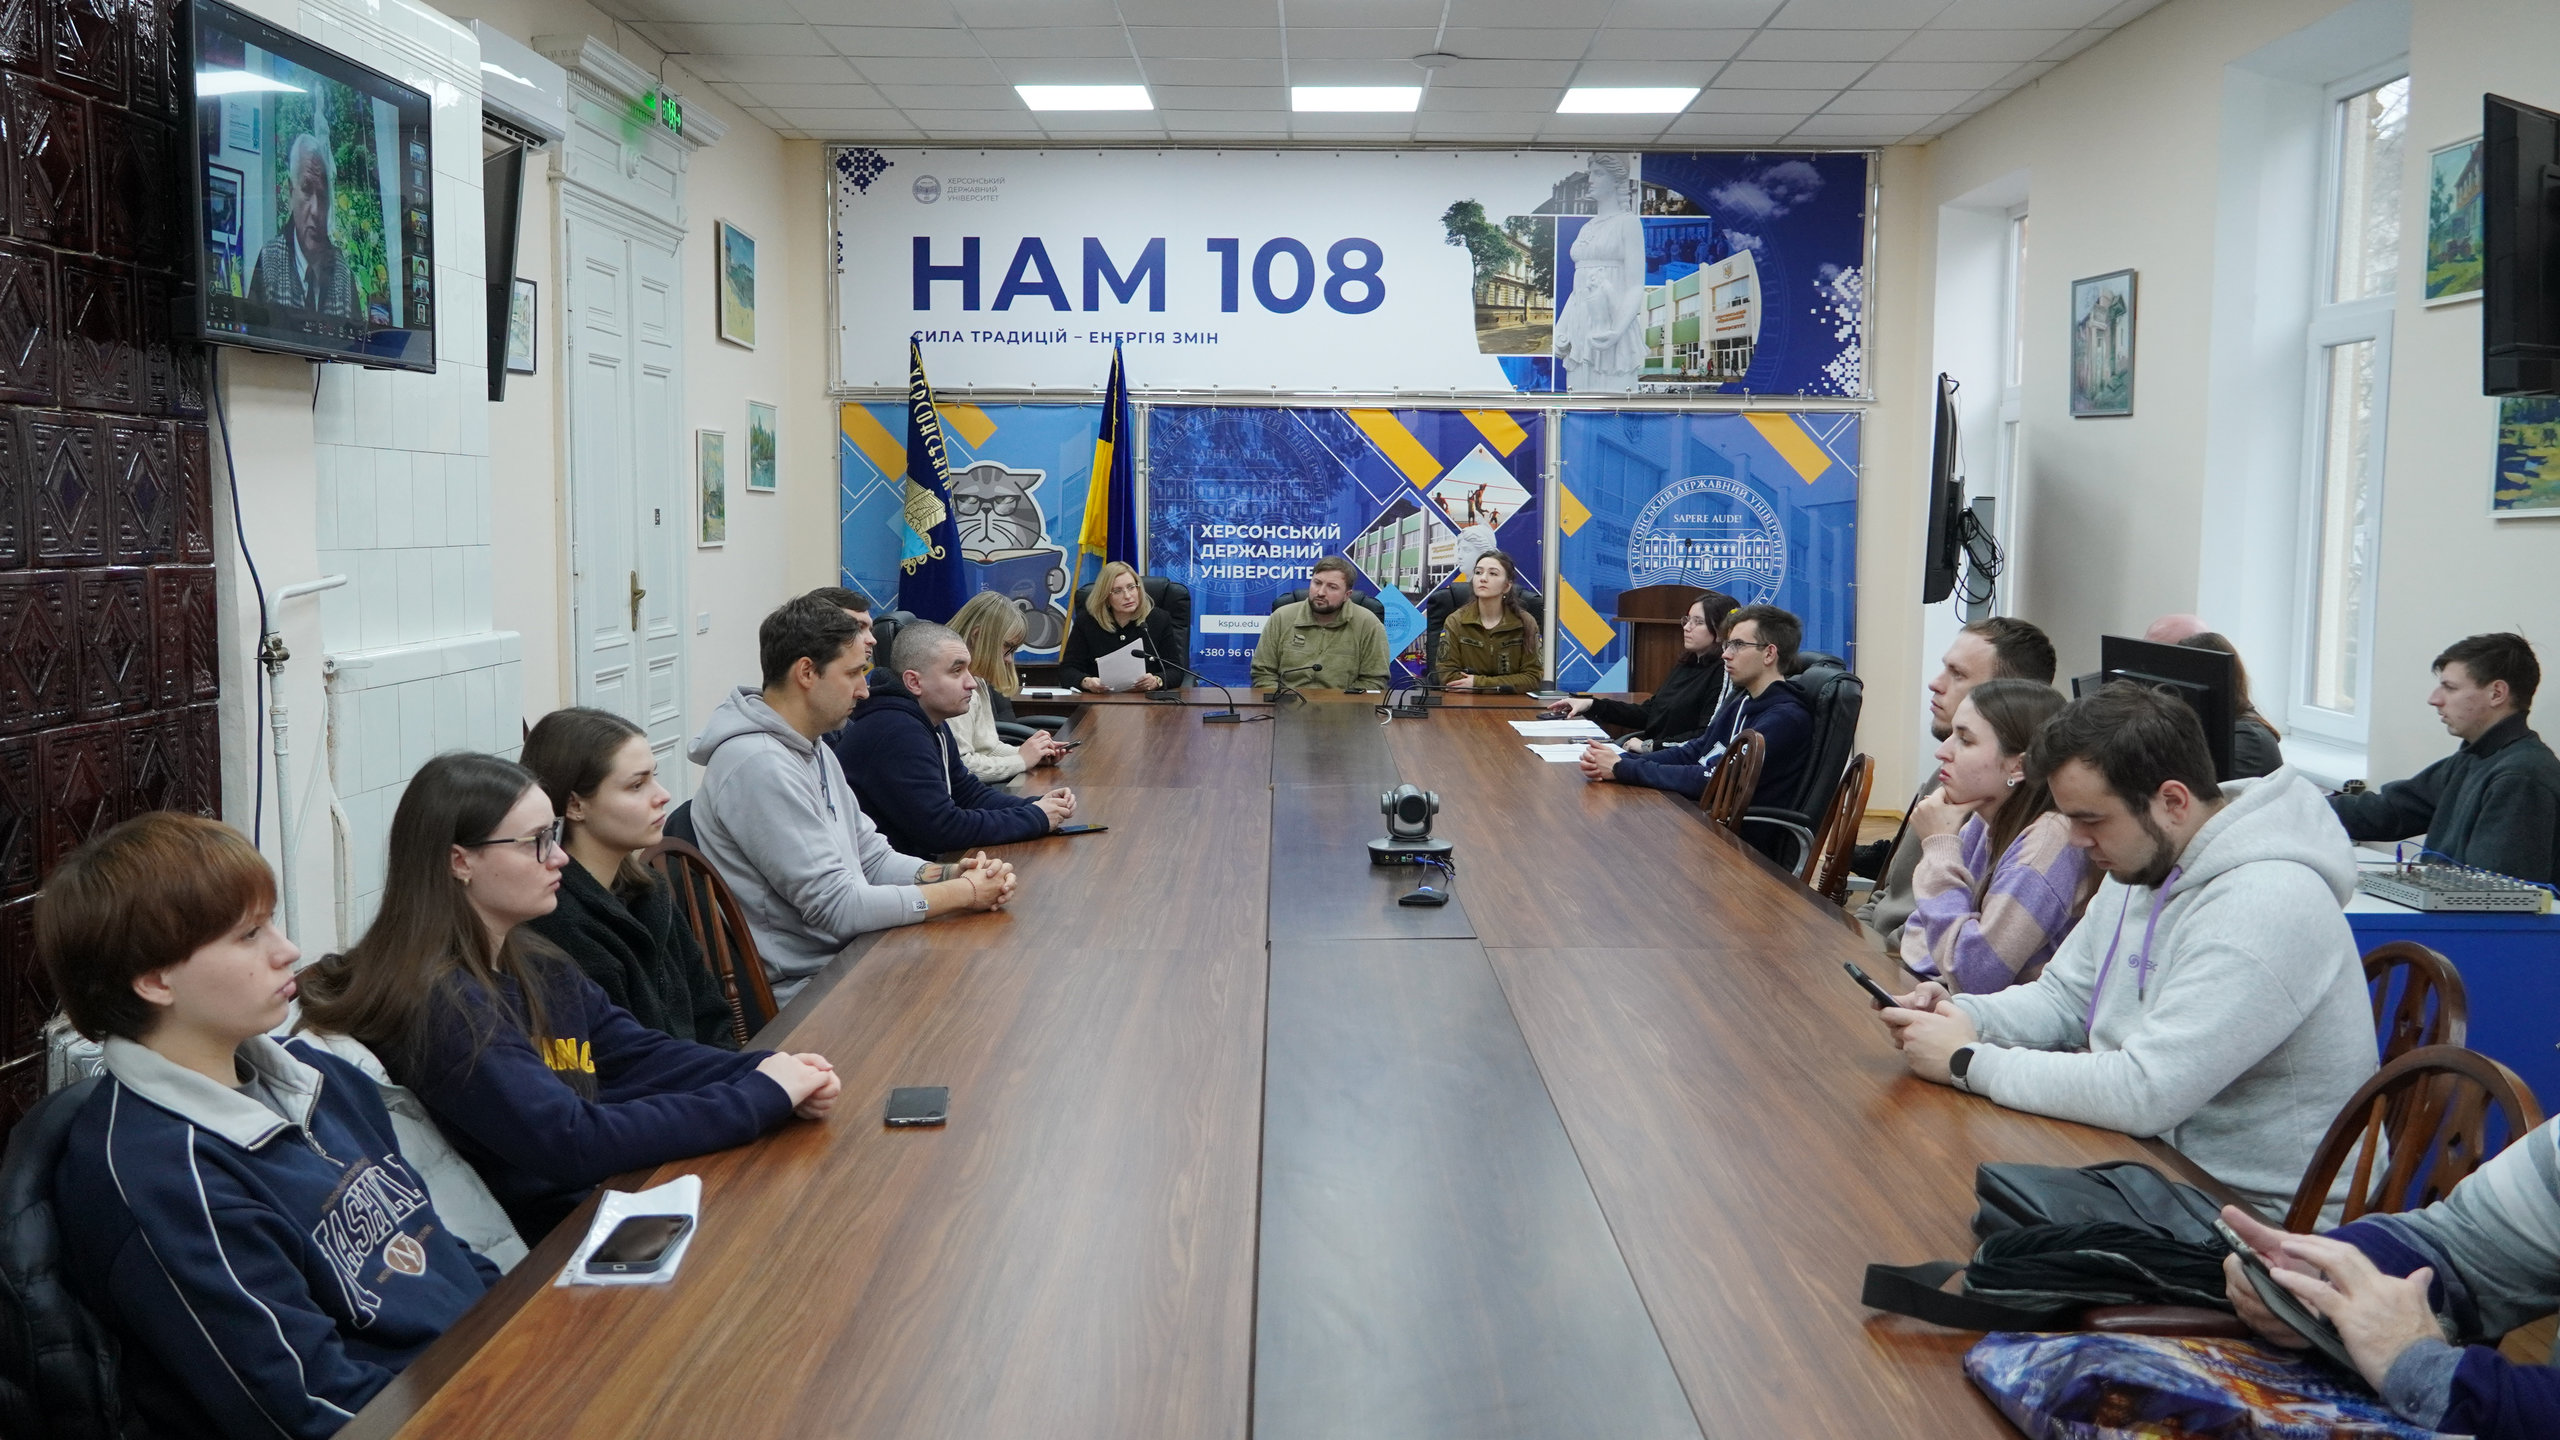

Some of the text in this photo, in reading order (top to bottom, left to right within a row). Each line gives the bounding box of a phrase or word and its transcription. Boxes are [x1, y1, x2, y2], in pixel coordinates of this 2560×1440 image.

[947, 176, 1005, 185] ХЕРСОНСЬКИЙ
[947, 194, 999, 202] УНІВЕРСИТЕТ
[912, 236, 1387, 314] НАМ 108
[970, 328, 1067, 345] ТРАДИЦІЙ
[1173, 331, 1218, 344] ЗМІН
[1673, 514, 1742, 523] SAPERE AUDE!
[1200, 523, 1341, 539] ХЕРСОНСЬКИЙ
[1200, 542, 1323, 559] ДЕРЖАВНИЙ
[1200, 565, 1315, 580] УНІВЕРСИТЕ
[1218, 619, 1260, 630] kspu.edu
[1199, 648, 1256, 657] +380 96 61
